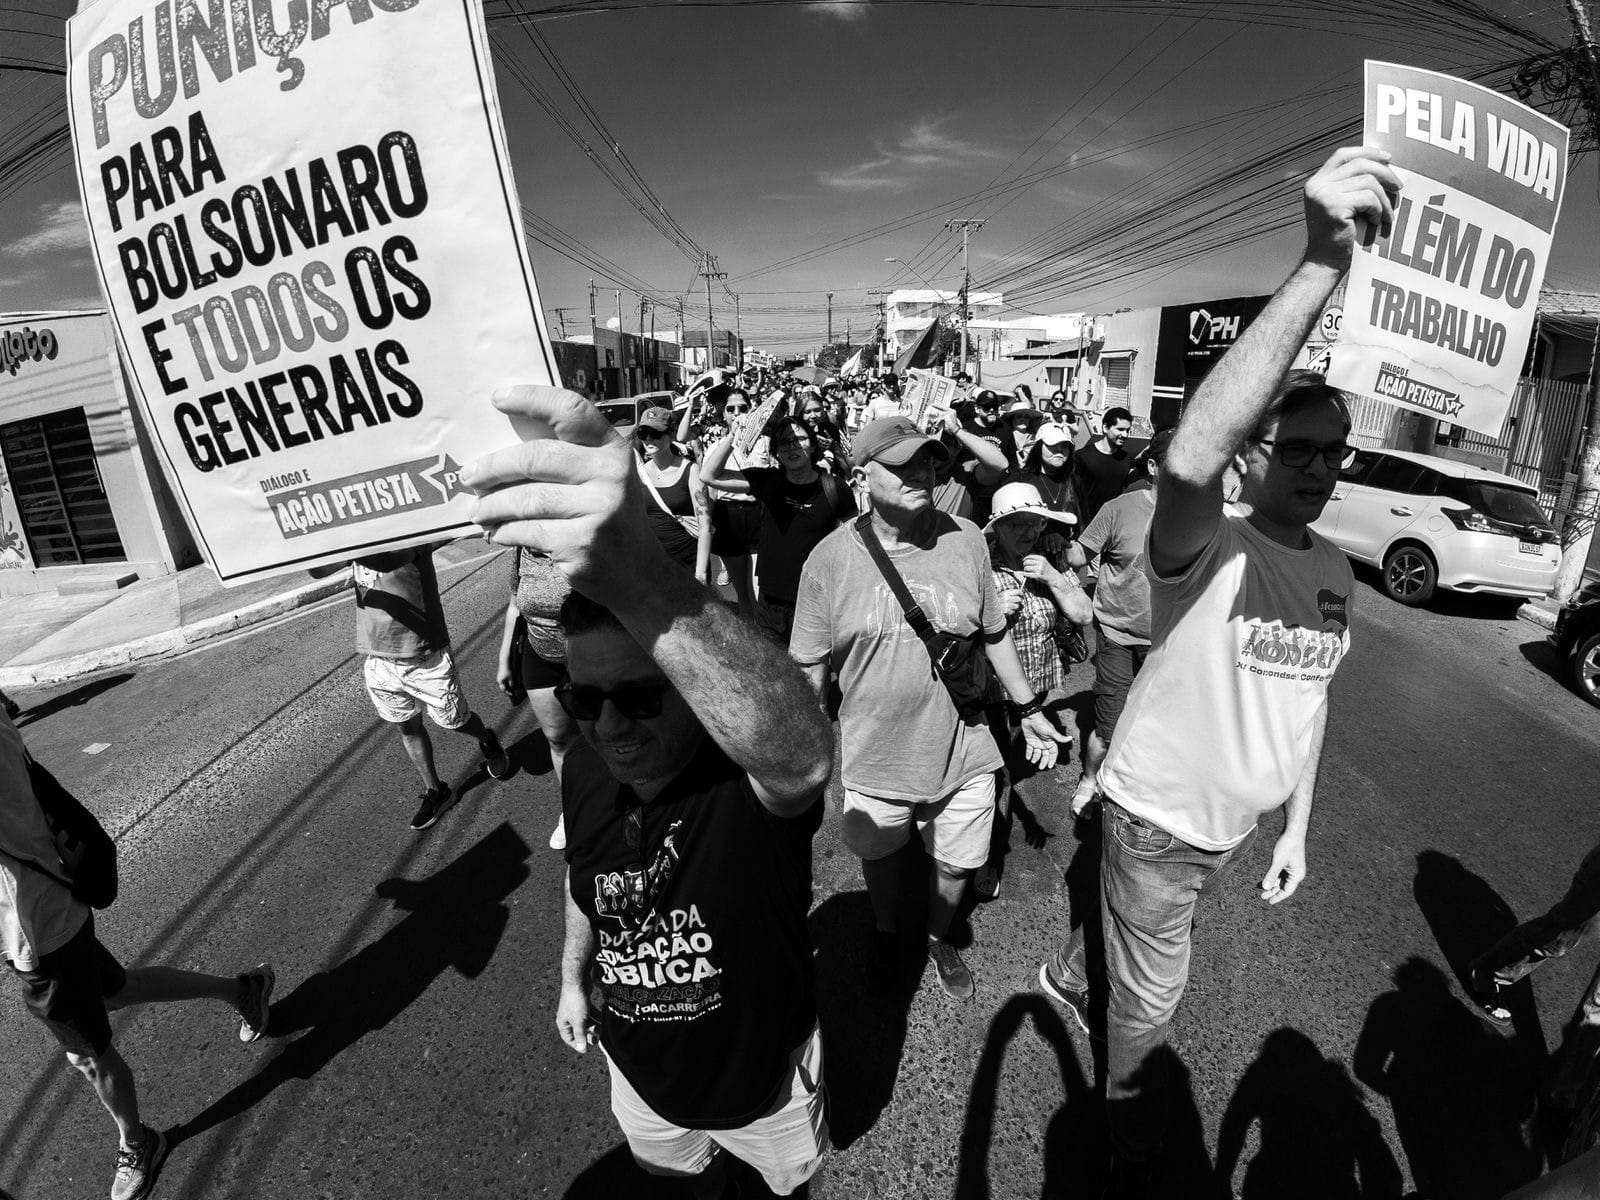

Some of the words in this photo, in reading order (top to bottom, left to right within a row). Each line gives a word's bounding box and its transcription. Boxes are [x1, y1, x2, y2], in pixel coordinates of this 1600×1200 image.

[88, 0, 419, 149] PUNIÇ
[100, 110, 226, 232] PARA
[1376, 83, 1475, 161] PELA
[1486, 112, 1558, 202] VIDA
[117, 130, 428, 315] BOLSONARO
[1480, 234, 1536, 309] DO
[142, 318, 189, 396] E
[172, 260, 349, 382] TODOS
[344, 235, 431, 330] OS
[1209, 315, 1241, 340] PH
[1369, 278, 1507, 368] TRABALHO
[173, 339, 424, 473] GENERAIS
[1376, 373, 1407, 396] AÇÃO
[1406, 382, 1446, 411] PETISTA
[1449, 401, 1462, 413] PT
[1380, 361, 1405, 376] DIÁLOGO
[1404, 368, 1410, 377] E
[260, 471, 303, 493] DIÁLOGO
[303, 469, 312, 482] E
[276, 490, 334, 535] AÇÃO
[329, 472, 422, 520] PETISTA
[670, 903, 706, 932] DA
